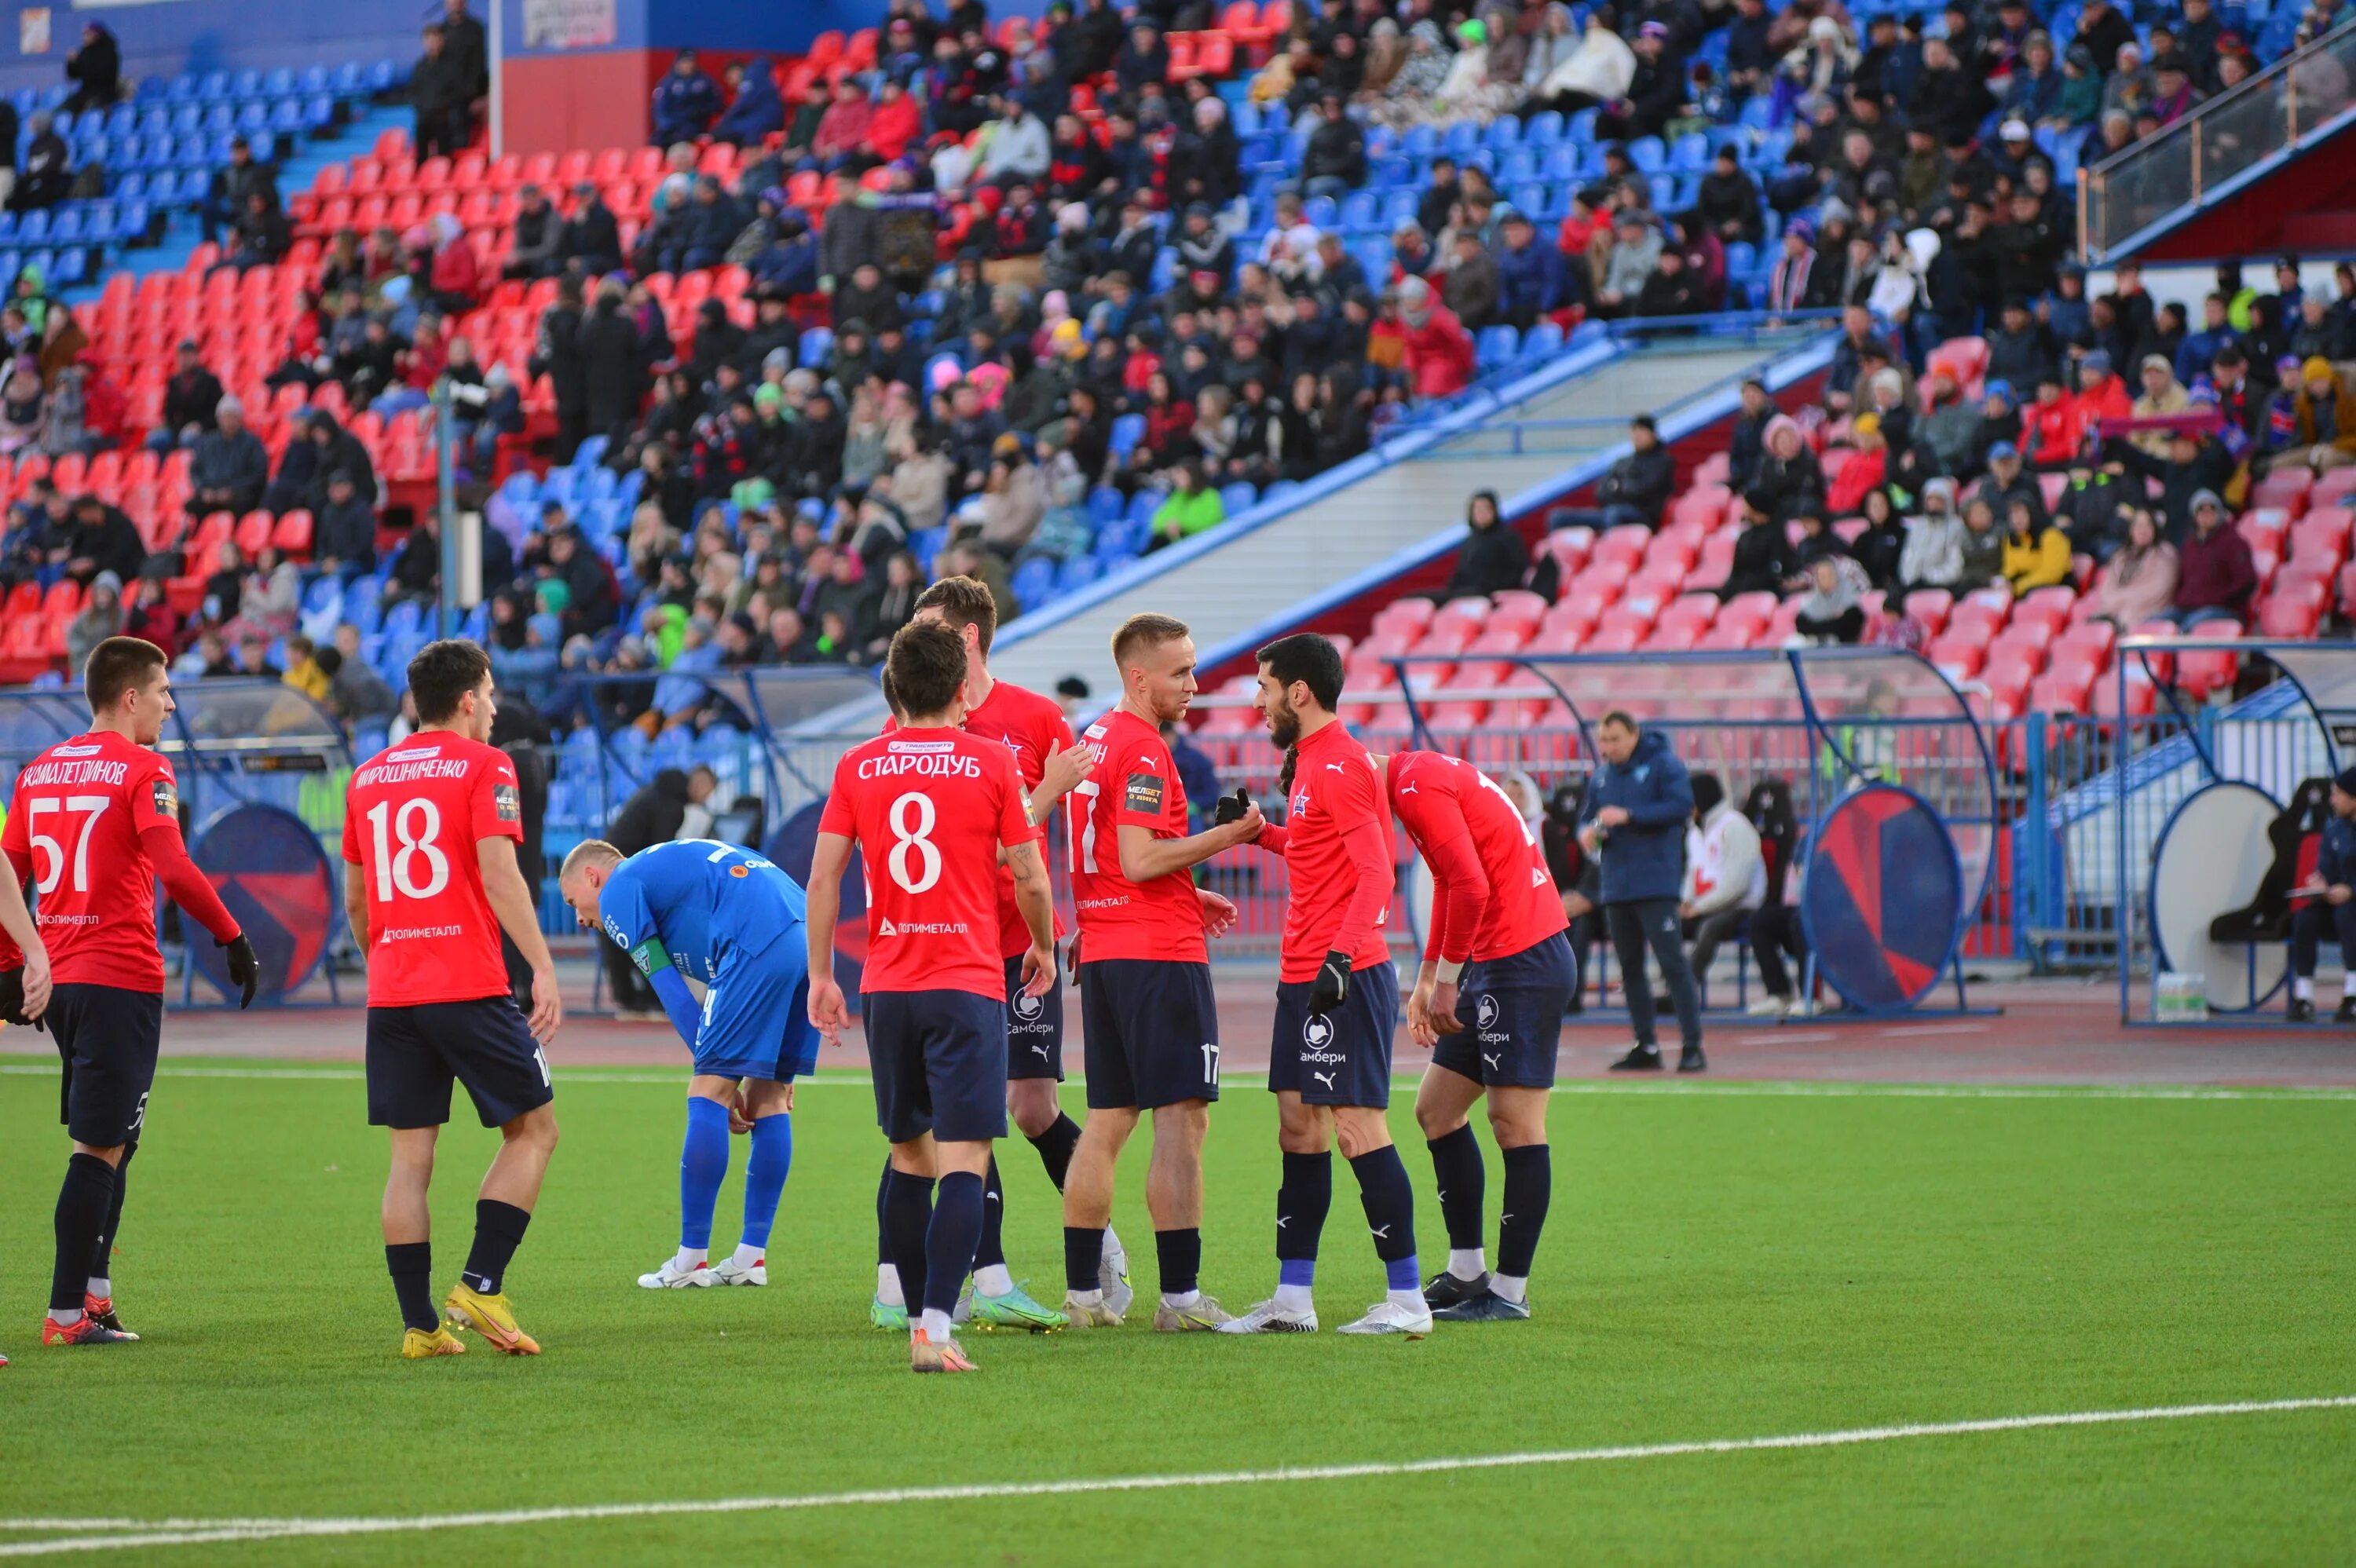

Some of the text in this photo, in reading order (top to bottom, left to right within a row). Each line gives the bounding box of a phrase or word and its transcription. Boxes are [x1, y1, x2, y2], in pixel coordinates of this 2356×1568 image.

[356, 759, 468, 789] МИРОШНИЧЕНКО
[858, 755, 981, 780] СТАРОДУБ
[1127, 785, 1162, 798] МЕЛБЕТ
[1136, 795, 1158, 805] ЛИГА
[30, 795, 110, 894] 57
[367, 798, 448, 902] 18
[888, 791, 942, 894] 8
[388, 925, 462, 940] ПОЛИМЕТАЛЛ
[898, 923, 968, 934] ПОЛИМЕТАЛЛ
[1007, 1021, 1054, 1036] Самбери
[533, 1044, 551, 1087] 1
[1201, 1043, 1220, 1085] 17
[1300, 1050, 1345, 1065] амбери
[128, 1091, 149, 1130] 5
